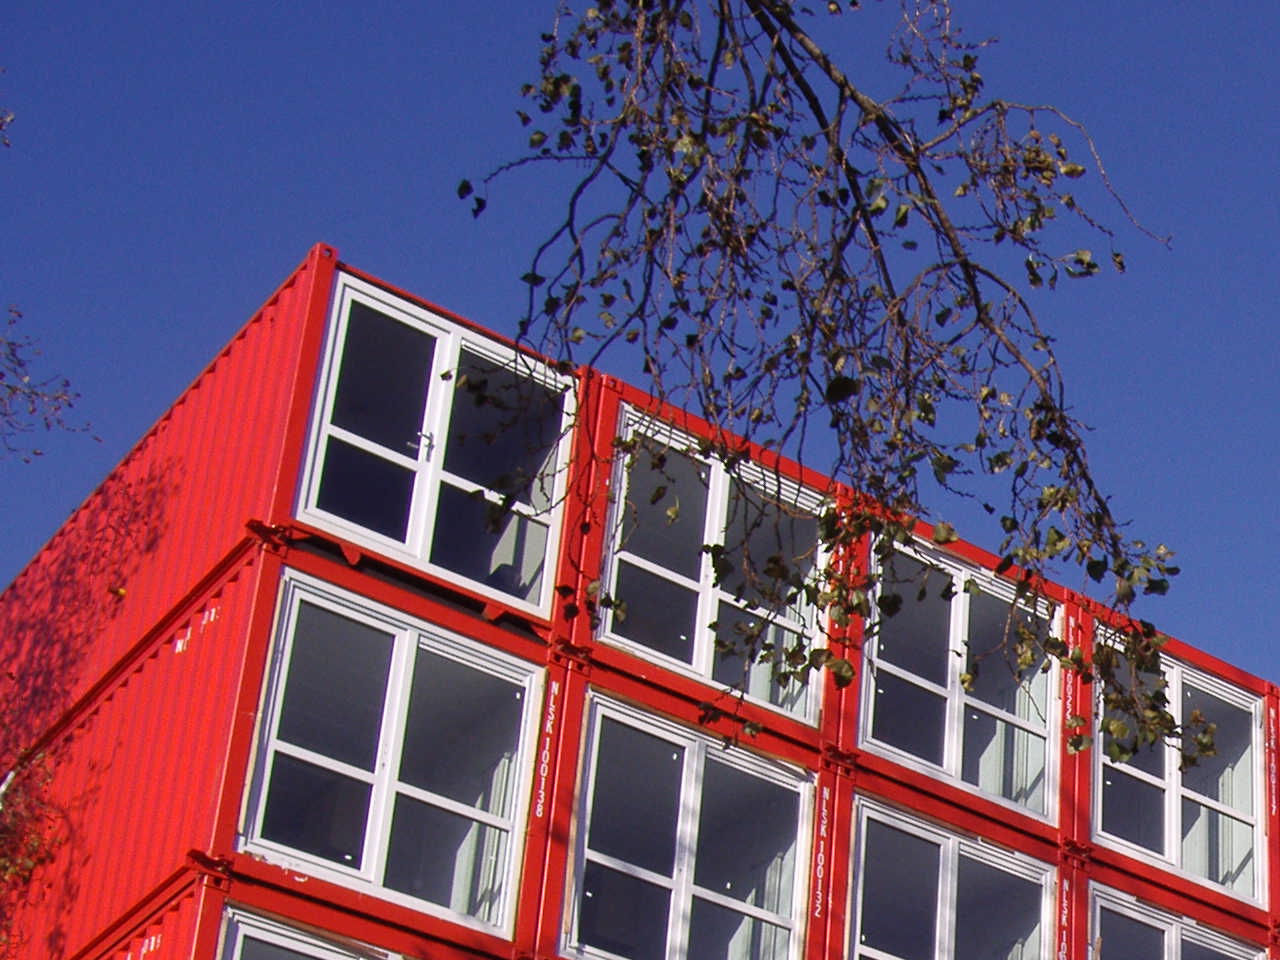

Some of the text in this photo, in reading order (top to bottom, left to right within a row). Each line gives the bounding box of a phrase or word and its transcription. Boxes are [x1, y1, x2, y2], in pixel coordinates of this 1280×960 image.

[536, 681, 560, 817] NLSK 100138
[815, 840, 825, 918] 100132
